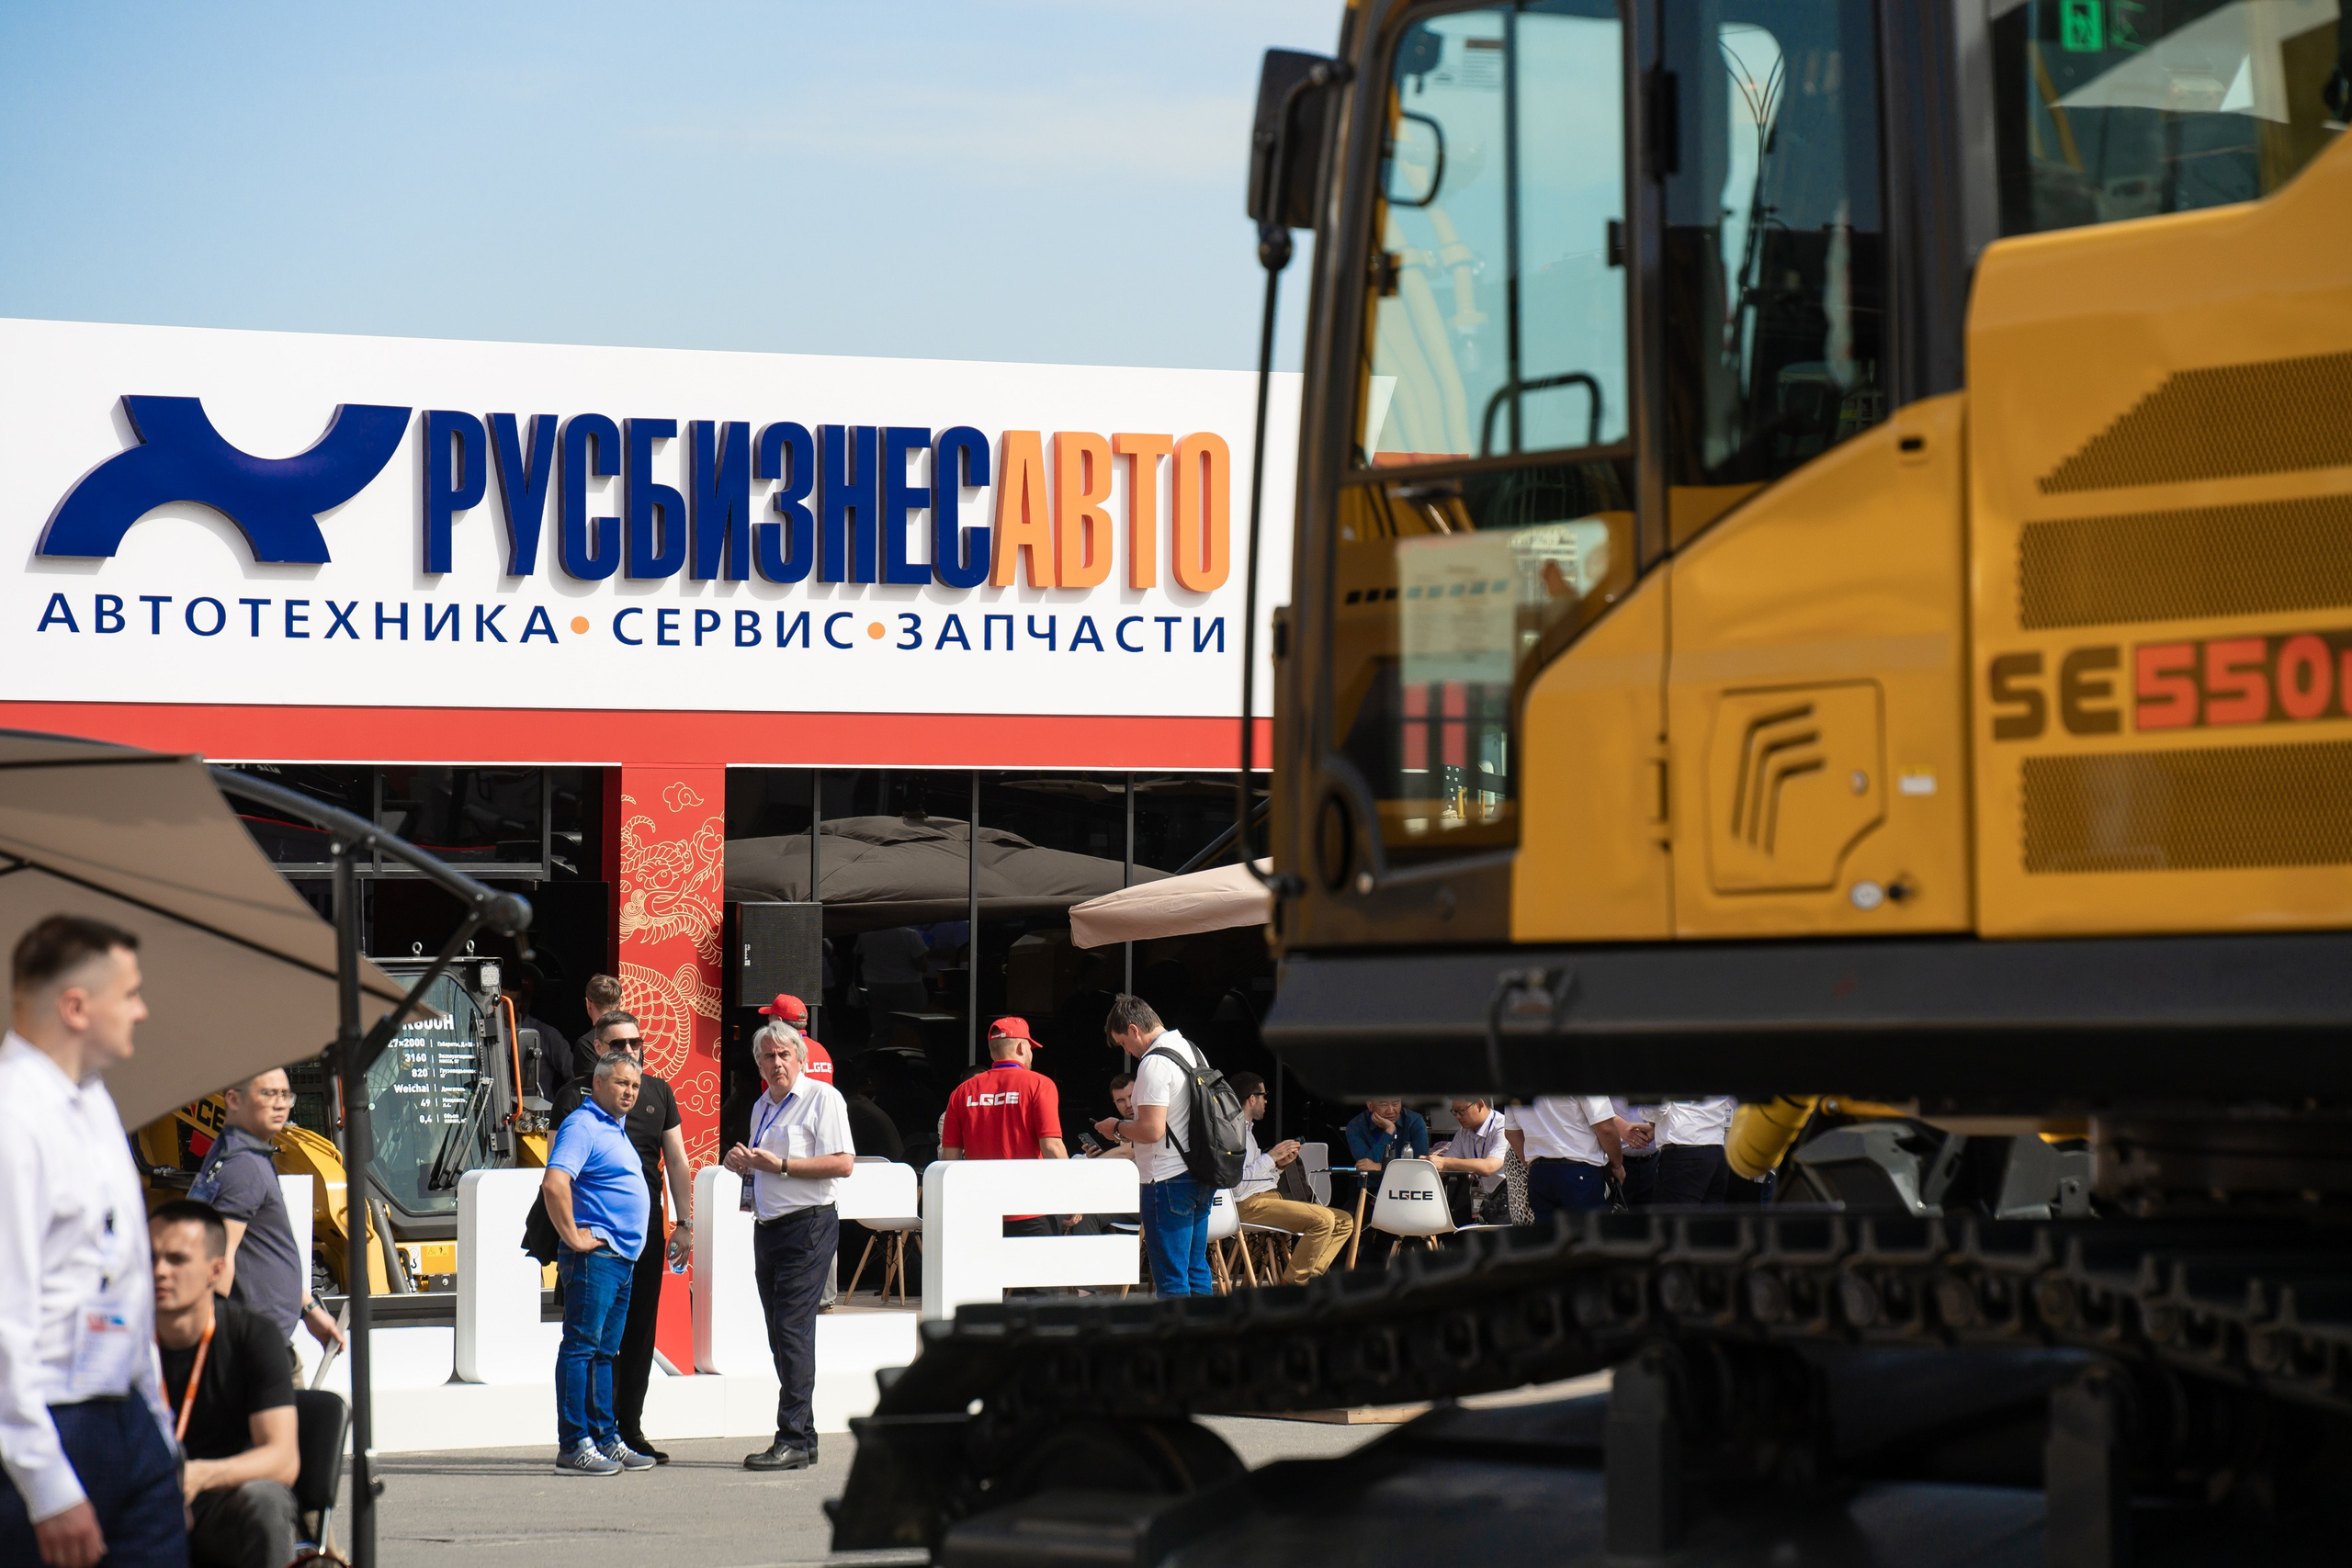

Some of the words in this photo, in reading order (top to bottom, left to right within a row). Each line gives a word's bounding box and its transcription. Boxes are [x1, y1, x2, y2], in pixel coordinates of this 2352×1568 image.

[37, 592, 559, 644] АВТОТЕХНИКА
[613, 607, 854, 649] СЕРВИС
[896, 613, 1225, 653] ЗАПЧАСТИ
[1989, 632, 2352, 742] SE550
[404, 1054, 427, 1063] 3160
[412, 1068, 428, 1078] 820
[393, 1083, 429, 1094] Weichai
[420, 1098, 431, 1108] 49
[967, 1091, 1019, 1107] LGCE
[419, 1114, 433, 1125] 0,4
[1388, 1190, 1433, 1201] LGCE
